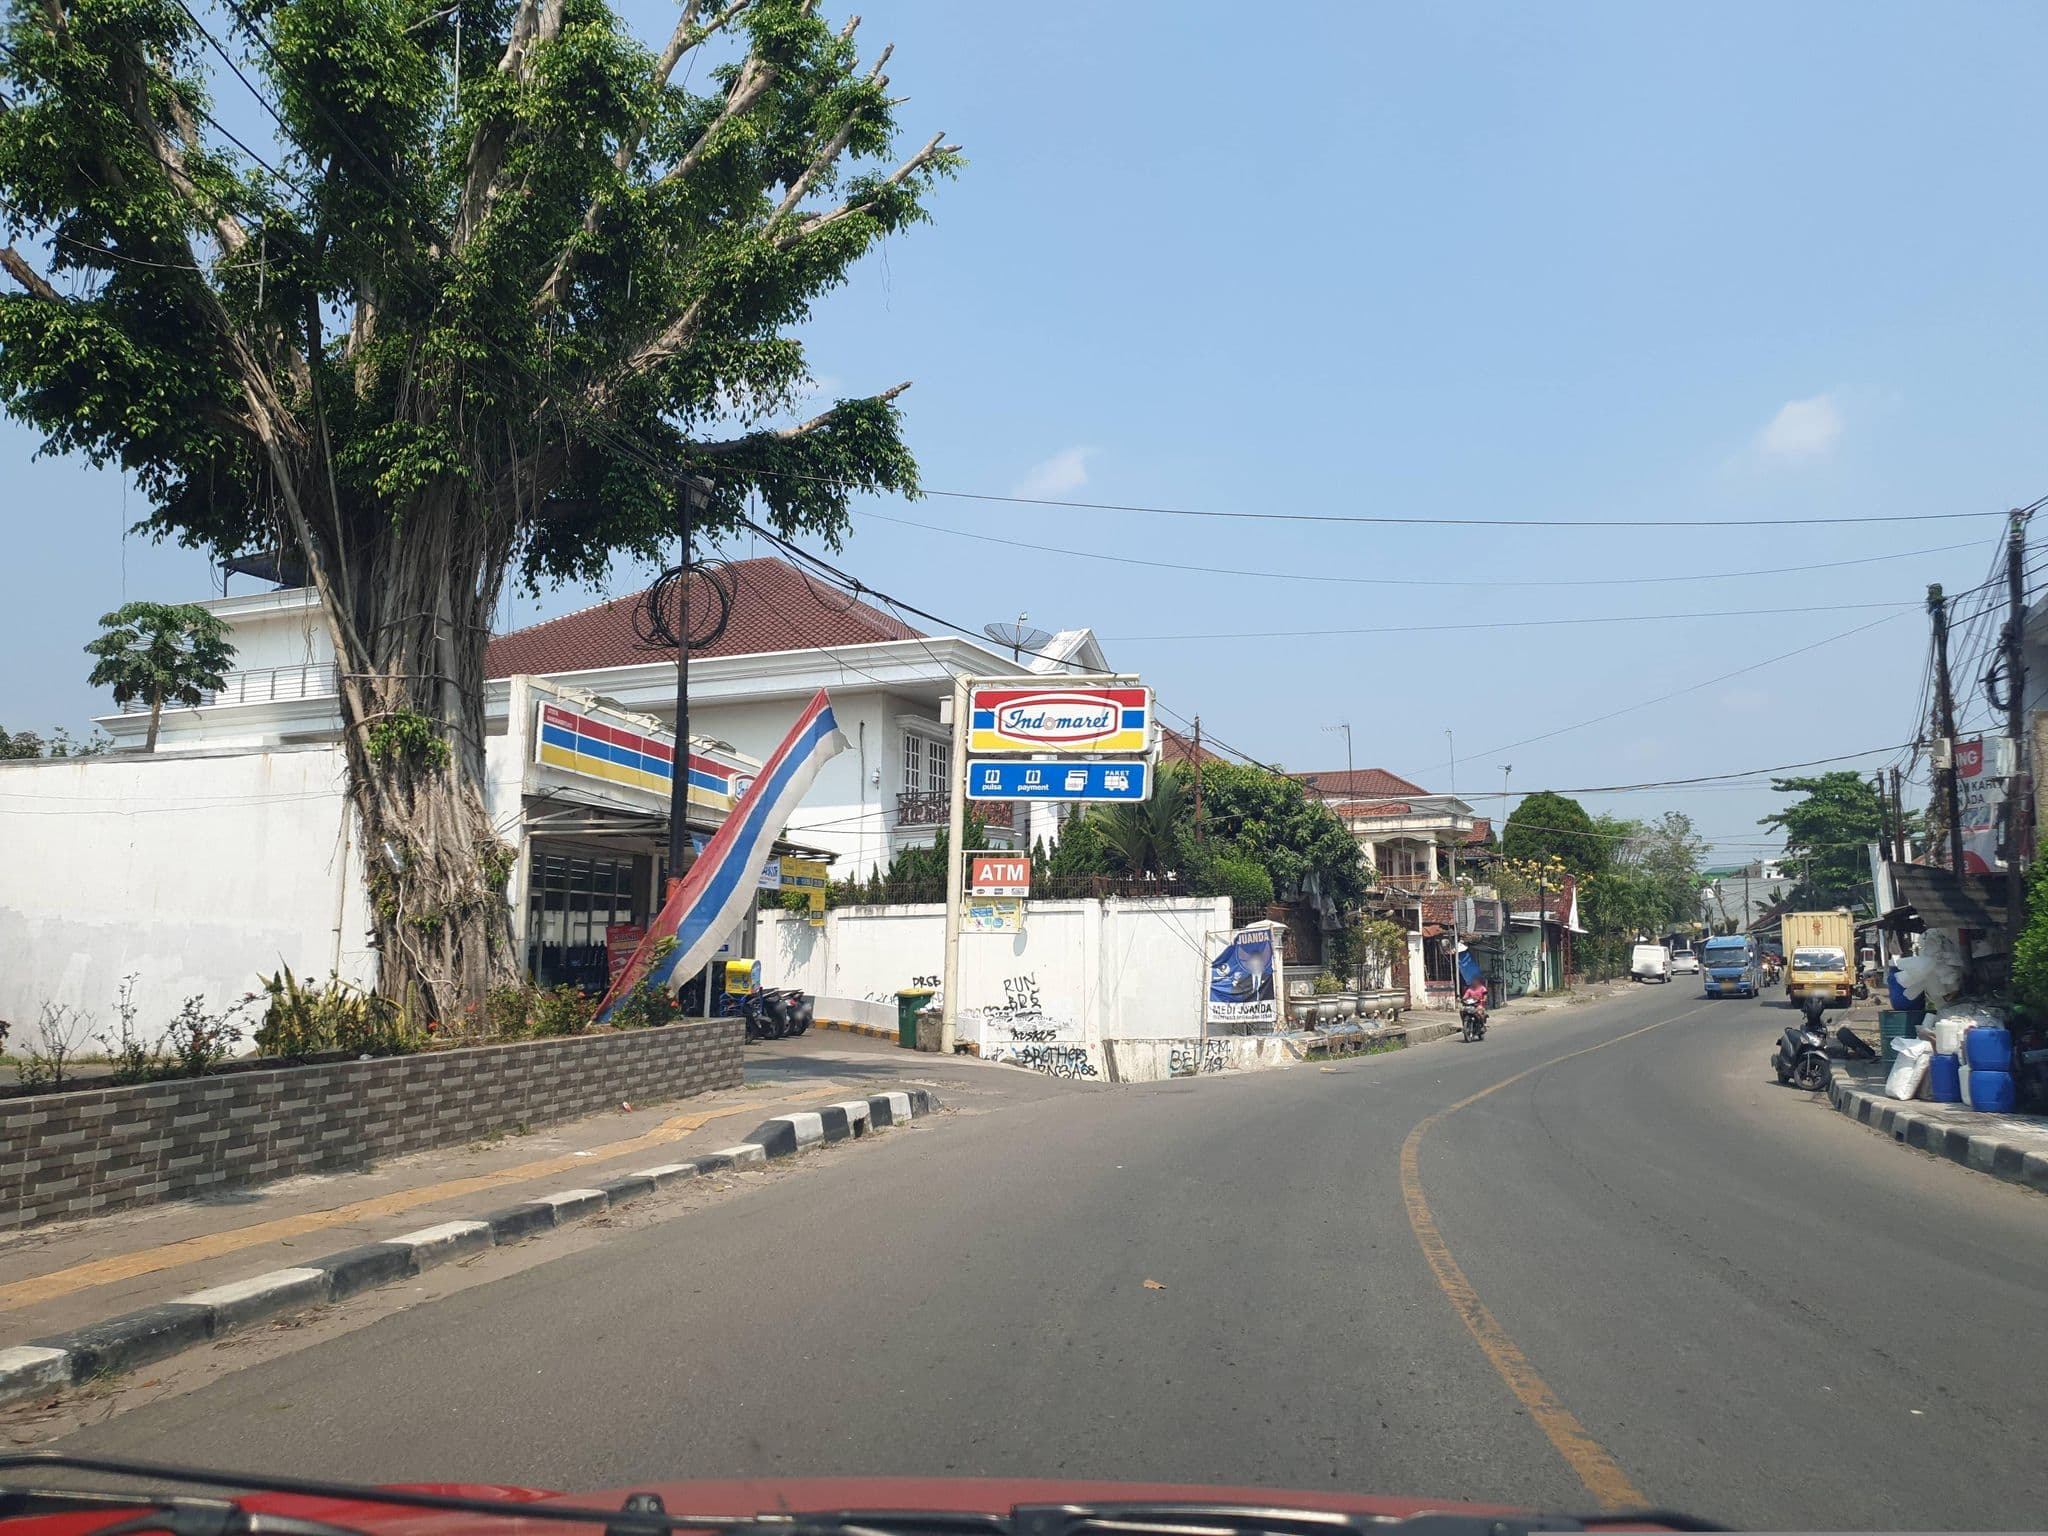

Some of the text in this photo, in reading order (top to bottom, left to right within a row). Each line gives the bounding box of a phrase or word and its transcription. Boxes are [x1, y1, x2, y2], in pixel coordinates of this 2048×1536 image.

[1005, 709, 1109, 731] Indomaret
[982, 783, 1050, 793] pulsa payment
[979, 863, 1024, 881] ATM
[1236, 931, 1269, 945] JUANDA
[1003, 972, 1036, 996] RUN
[1238, 1002, 1272, 1015] JUANDA
